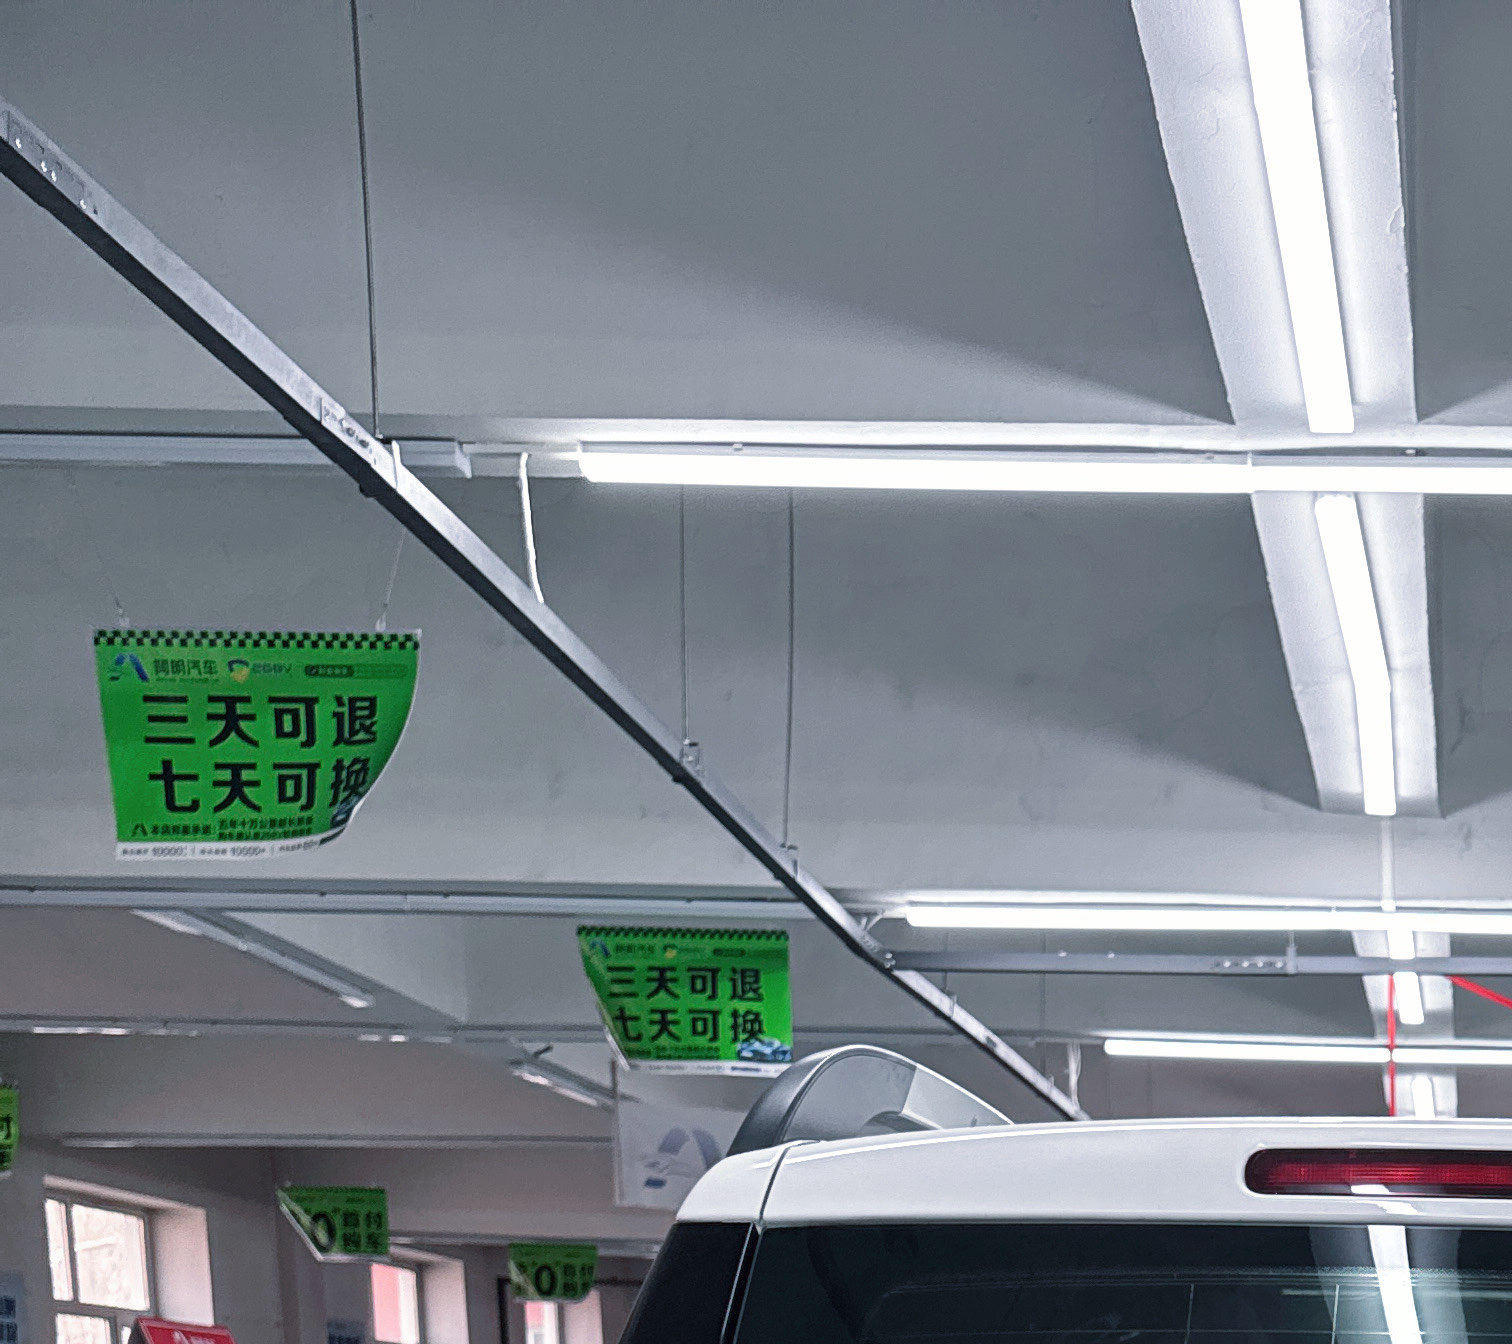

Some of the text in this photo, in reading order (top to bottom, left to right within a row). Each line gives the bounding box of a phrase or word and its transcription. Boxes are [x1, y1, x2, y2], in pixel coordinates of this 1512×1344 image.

[142, 695, 378, 748] 三天可退
[149, 757, 371, 813] 七天可换
[606, 965, 764, 1003] 三天可退
[614, 1007, 766, 1044] 七天可换
